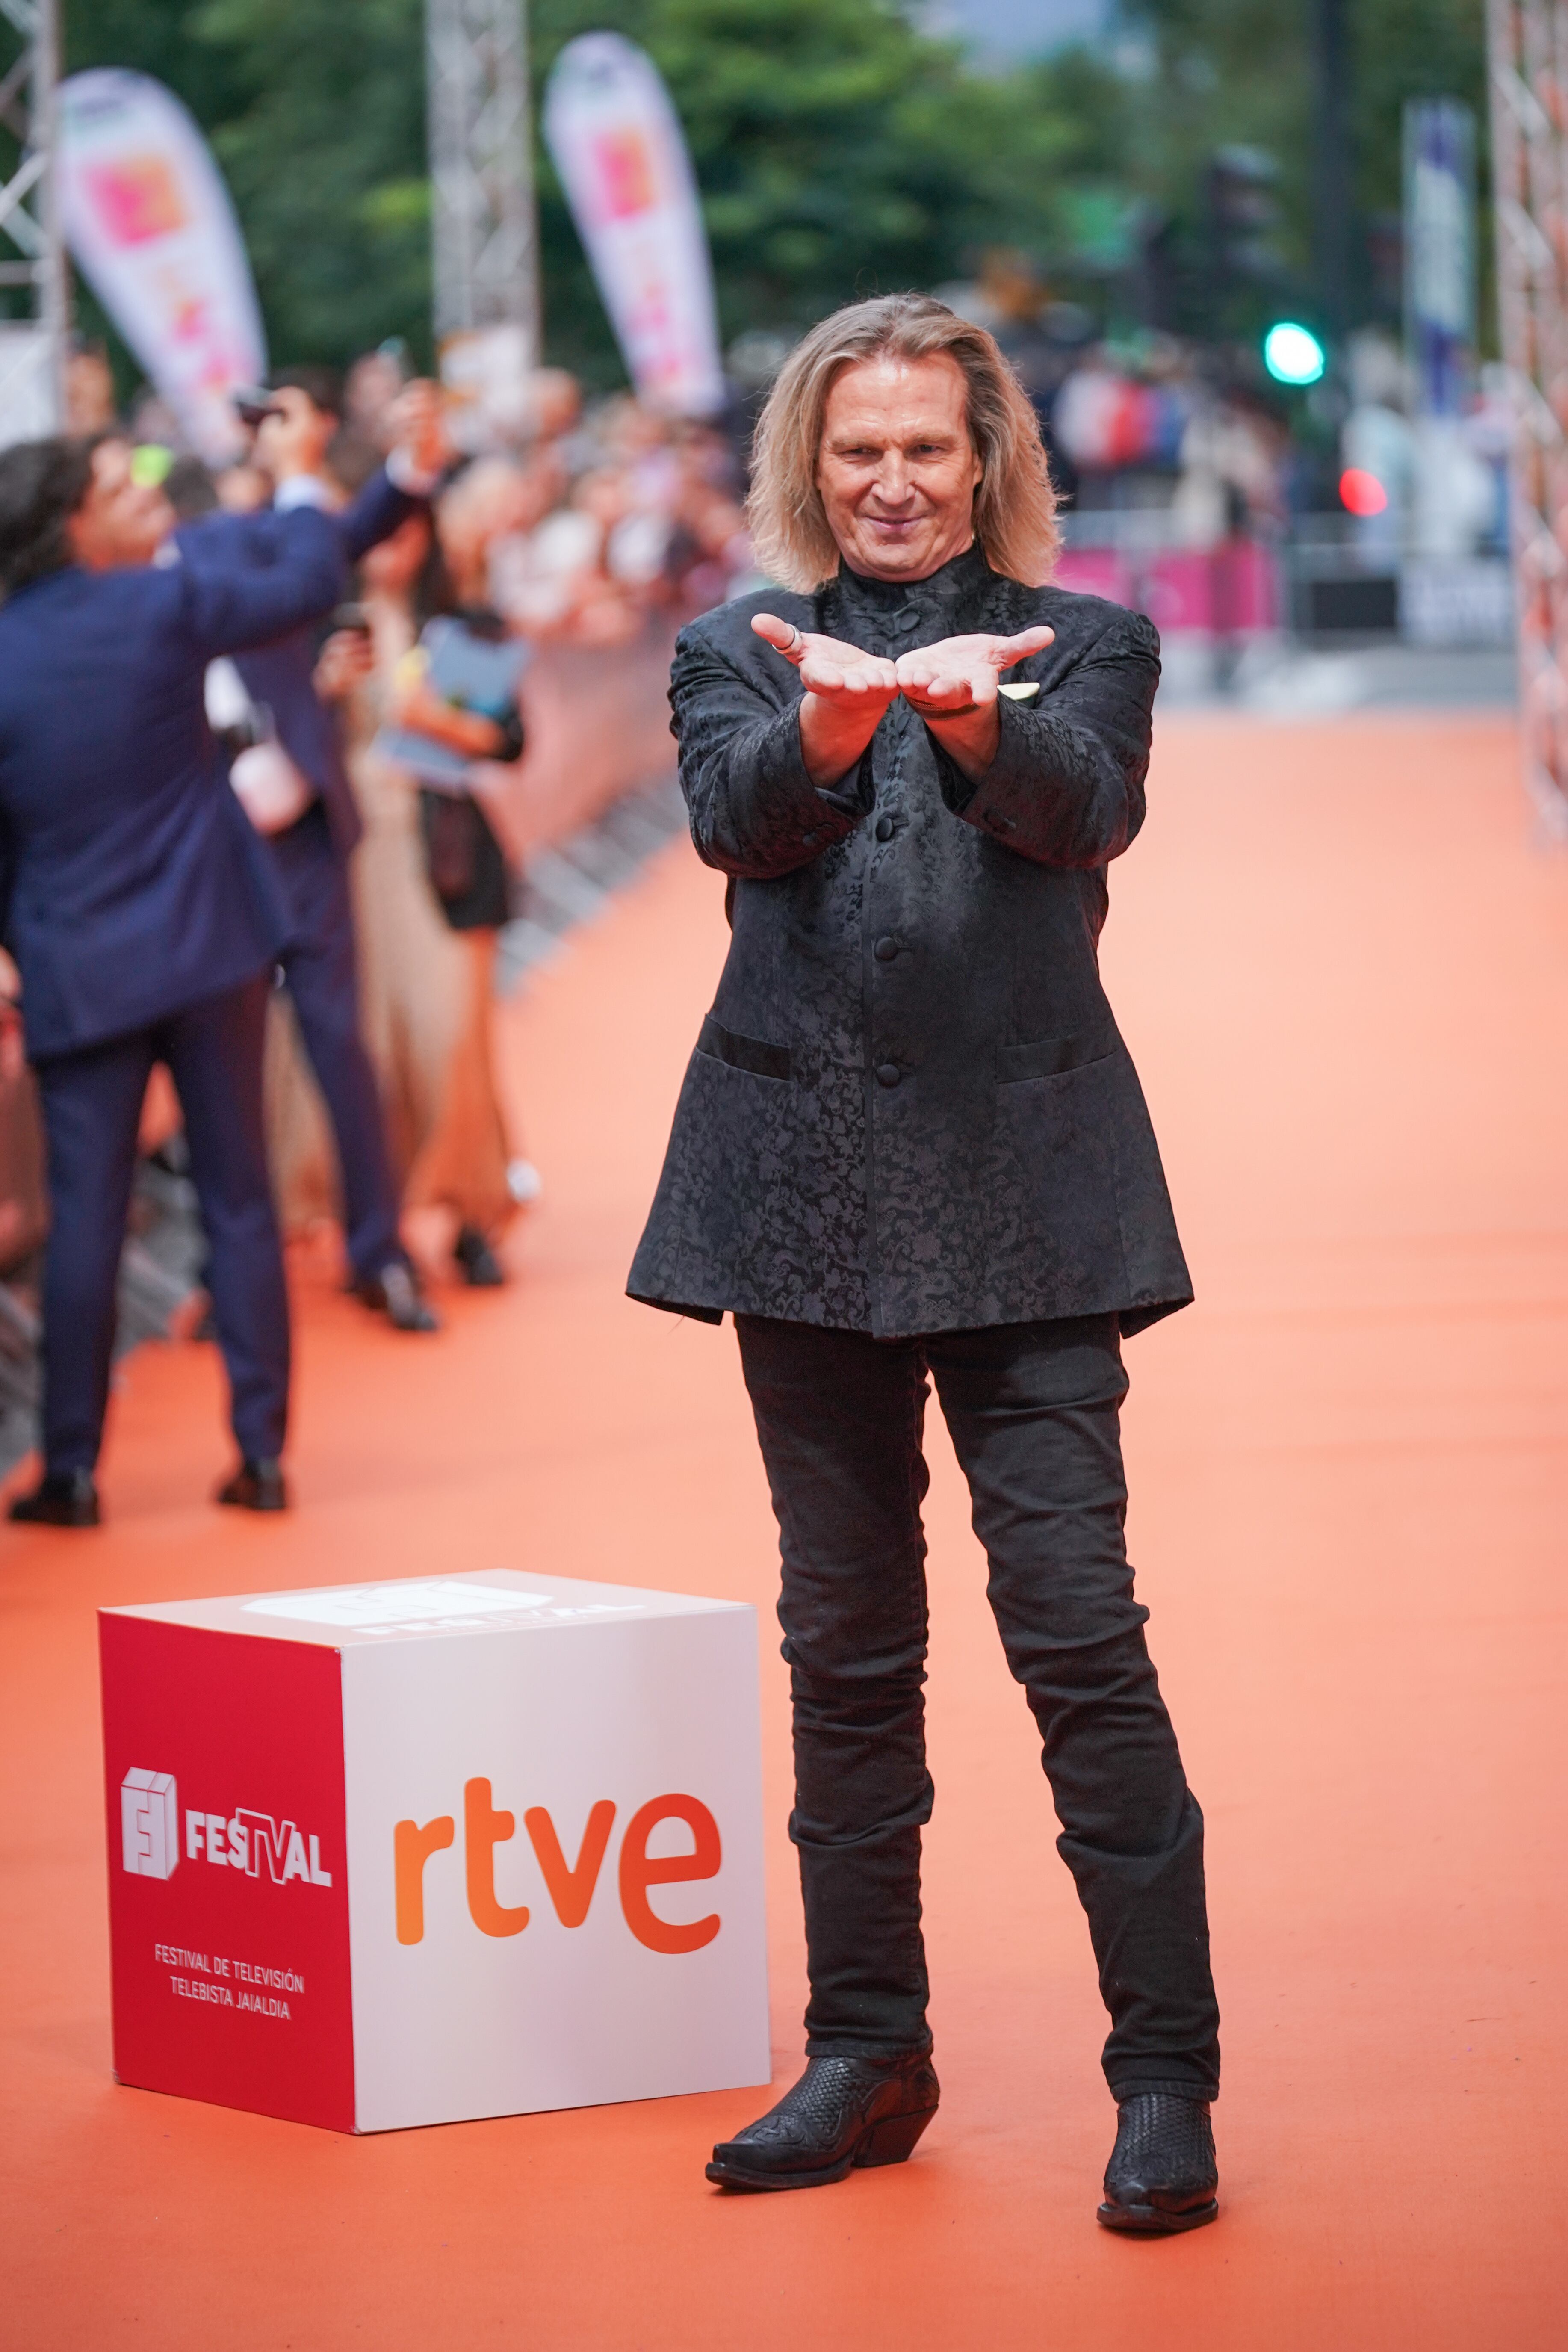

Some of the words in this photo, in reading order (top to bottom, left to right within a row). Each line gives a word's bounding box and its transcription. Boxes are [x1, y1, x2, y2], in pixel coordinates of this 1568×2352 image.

[394, 1777, 721, 1954] rtve
[155, 1944, 212, 1973] FESTIVAL
[214, 1956, 231, 1977] DE
[233, 1961, 305, 1994] TELEVISIÓN
[170, 1976, 234, 2006] TELEBISTA
[236, 1991, 291, 2020] JAIALDIA
